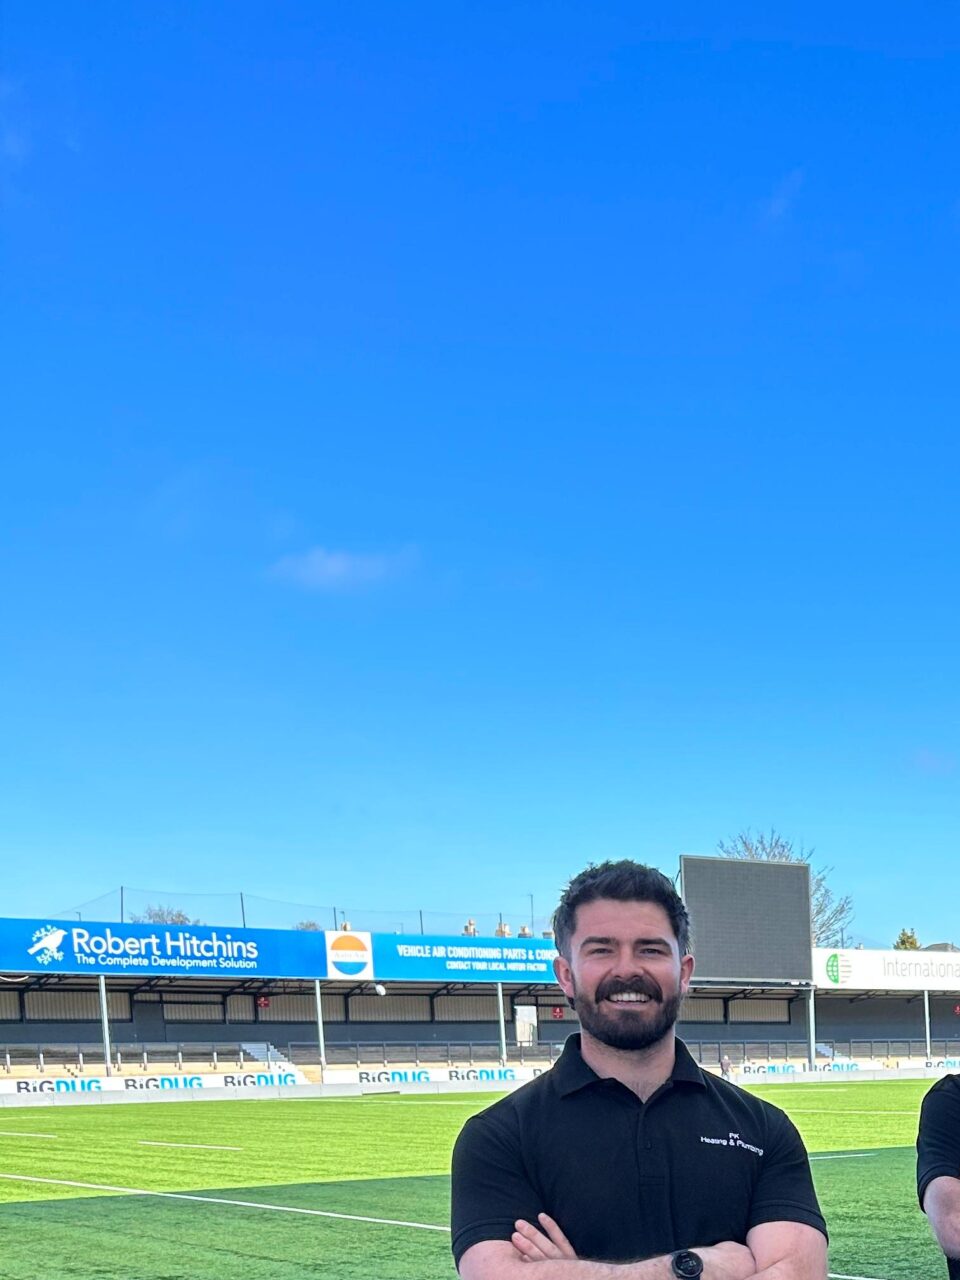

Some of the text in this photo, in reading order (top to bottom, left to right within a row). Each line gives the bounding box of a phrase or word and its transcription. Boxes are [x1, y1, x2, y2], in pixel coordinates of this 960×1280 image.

[71, 927, 259, 958] Robert Hitchins
[396, 944, 431, 958] VEHICLE
[432, 946, 447, 958] AIR
[447, 946, 502, 959] CONDITIONING
[503, 948, 527, 960] PARTS
[528, 949, 534, 960] &
[75, 953, 258, 970] The Complete Development Solution
[700, 1136, 728, 1146] Heating
[736, 1140, 764, 1156] Plumbing
